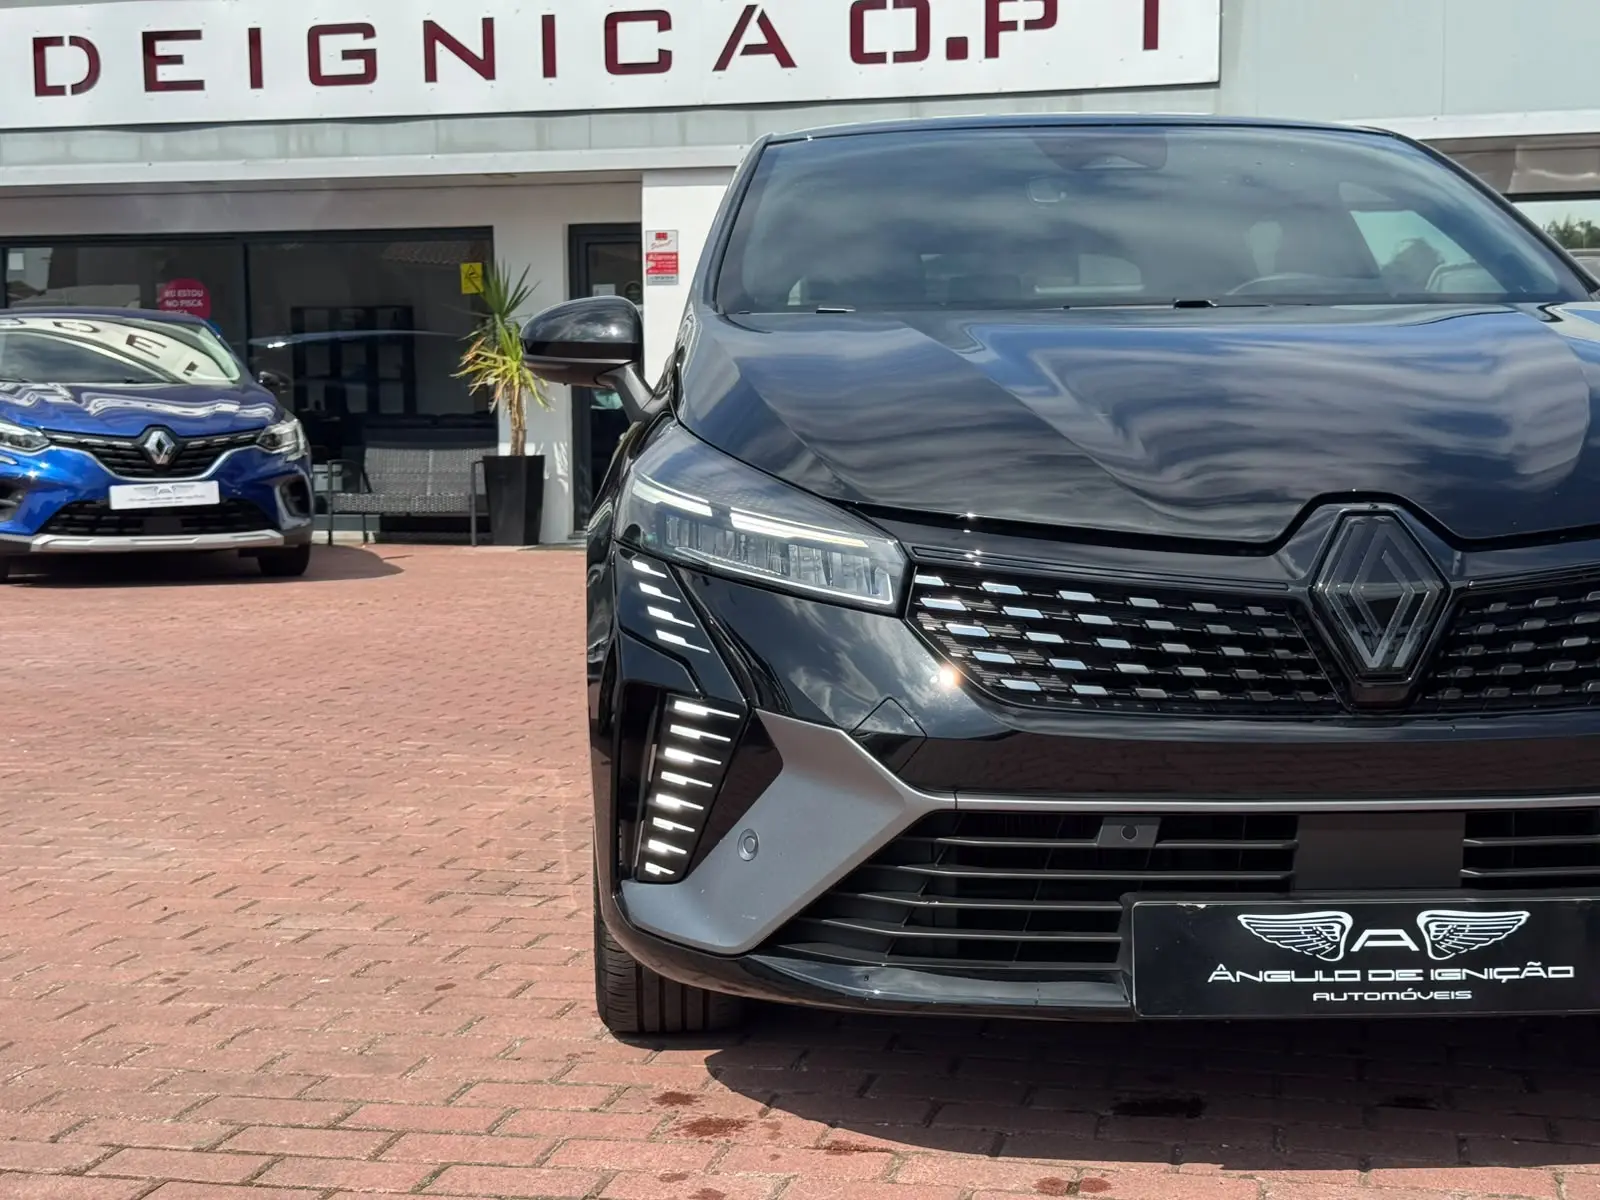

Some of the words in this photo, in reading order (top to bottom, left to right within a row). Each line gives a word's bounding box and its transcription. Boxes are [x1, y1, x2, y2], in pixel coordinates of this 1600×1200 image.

[177, 288, 204, 298] ESTOU
[165, 299, 179, 307] NO
[1207, 963, 1361, 983] ÂNGULO
[1367, 968, 1424, 982] DE
[1430, 961, 1575, 983] IGNIÇÃO
